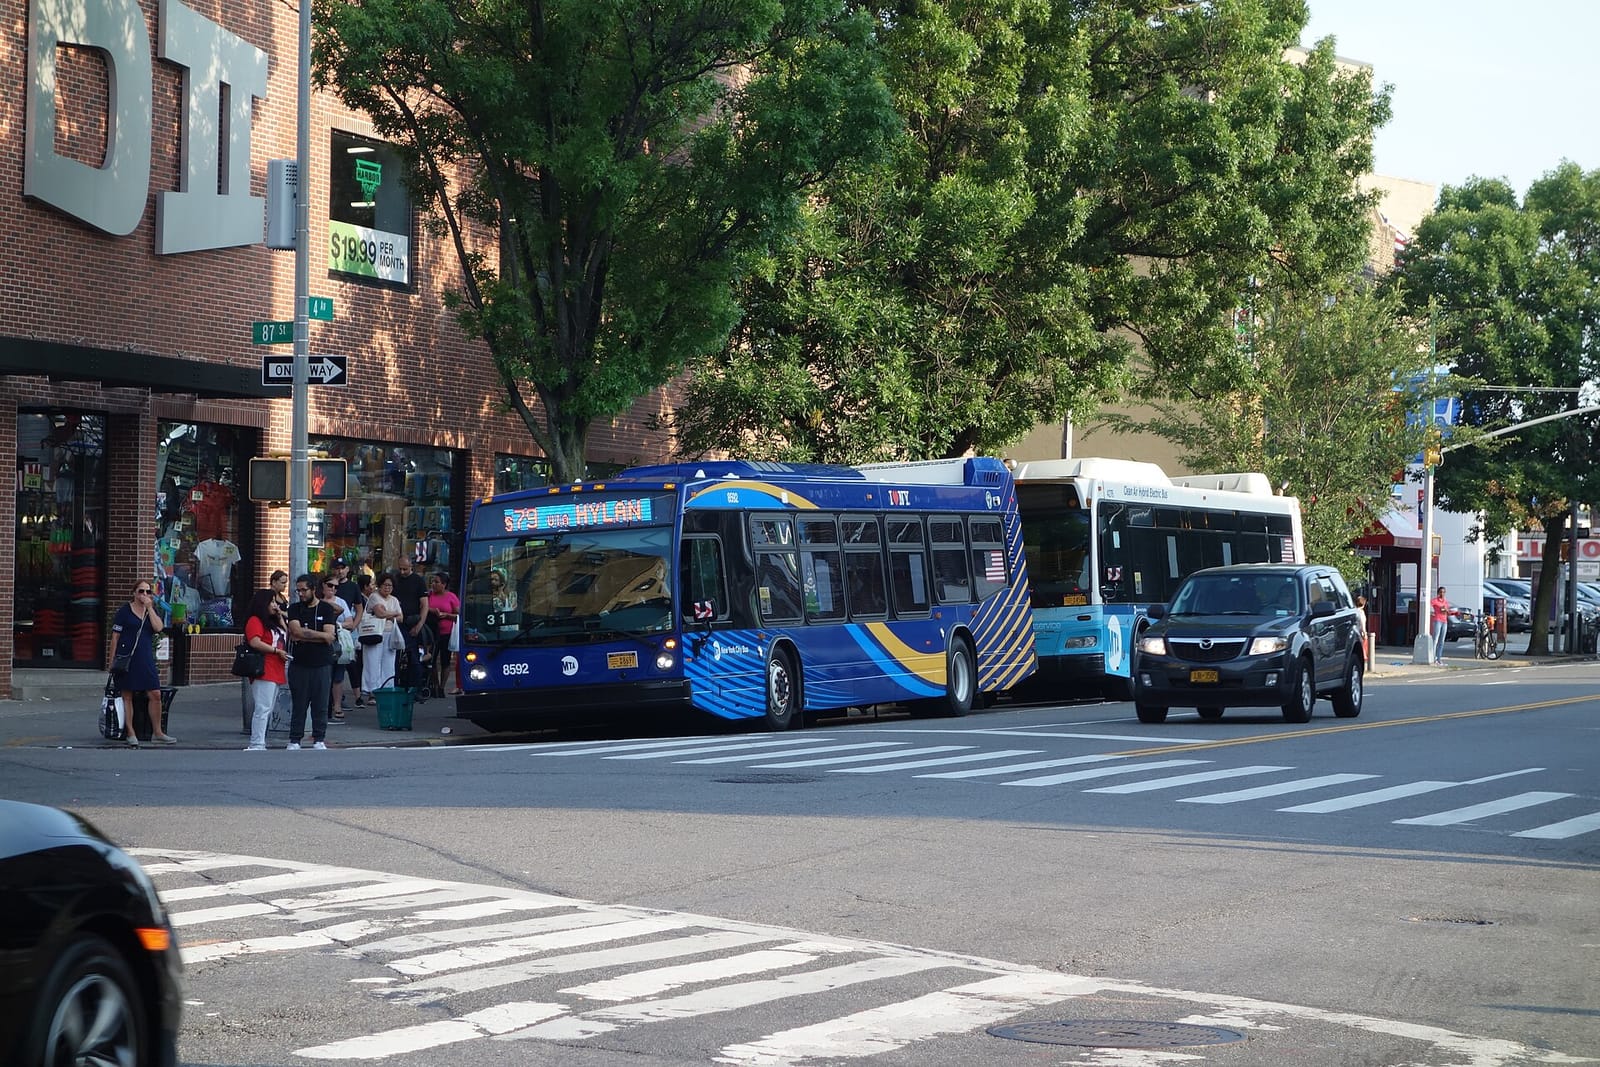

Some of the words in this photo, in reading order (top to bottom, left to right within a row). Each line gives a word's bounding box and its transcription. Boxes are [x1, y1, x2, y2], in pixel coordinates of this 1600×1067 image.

[331, 231, 377, 265] $19.99
[379, 241, 394, 255] PER
[379, 254, 405, 270] MONTH
[313, 299, 318, 316] 4
[262, 324, 275, 341] 87
[278, 324, 286, 335] St
[275, 364, 291, 376] ON
[309, 364, 334, 376] WAY
[727, 492, 739, 504] 8592
[1124, 485, 1133, 496] Clean
[1138, 486, 1149, 499] Hybrid
[1149, 487, 1161, 498] Electric
[504, 507, 538, 532] S79
[575, 499, 642, 526] HYLAN
[502, 662, 529, 676] 8592
